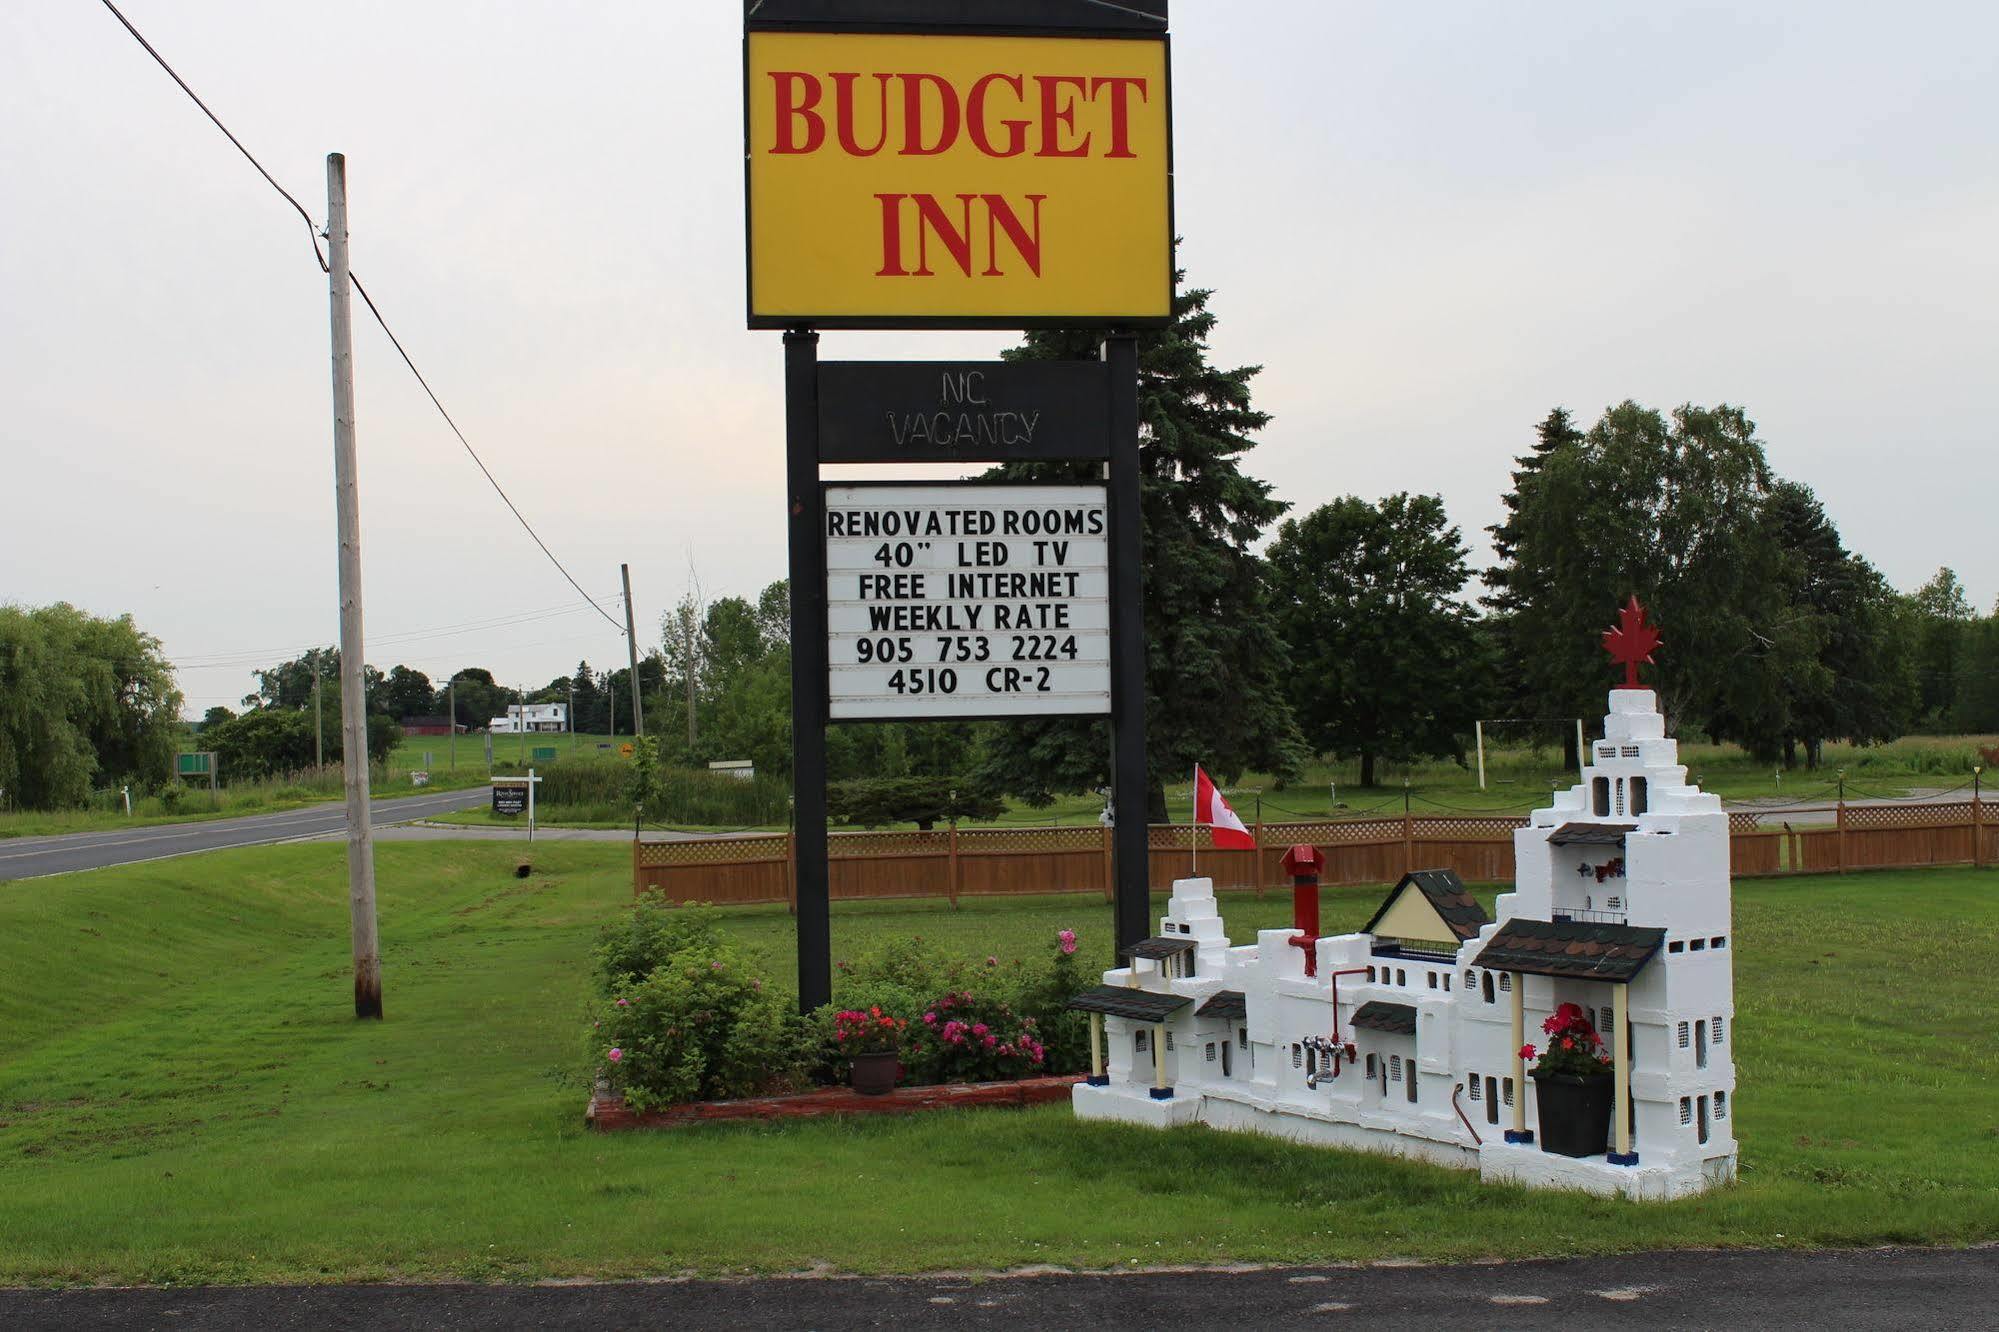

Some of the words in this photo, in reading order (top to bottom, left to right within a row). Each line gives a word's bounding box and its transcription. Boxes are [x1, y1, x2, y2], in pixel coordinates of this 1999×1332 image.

[767, 71, 1148, 158] BUDGET
[874, 193, 1047, 278] INN
[887, 411, 1040, 445] VACANCY
[828, 511, 995, 536] RENOVATED
[1004, 510, 1103, 535] ROOMS
[959, 542, 1008, 567] LED
[1033, 541, 1068, 565] TV
[860, 574, 925, 599] FREE
[949, 573, 1079, 598] INTERNET
[869, 605, 983, 631] WEEKLY
[995, 604, 1069, 630] RATE
[857, 638, 912, 663] 905
[938, 636, 989, 662] 753
[1012, 635, 1077, 660] 2224
[888, 669, 957, 694] 4510
[986, 667, 1050, 692] CR-2
